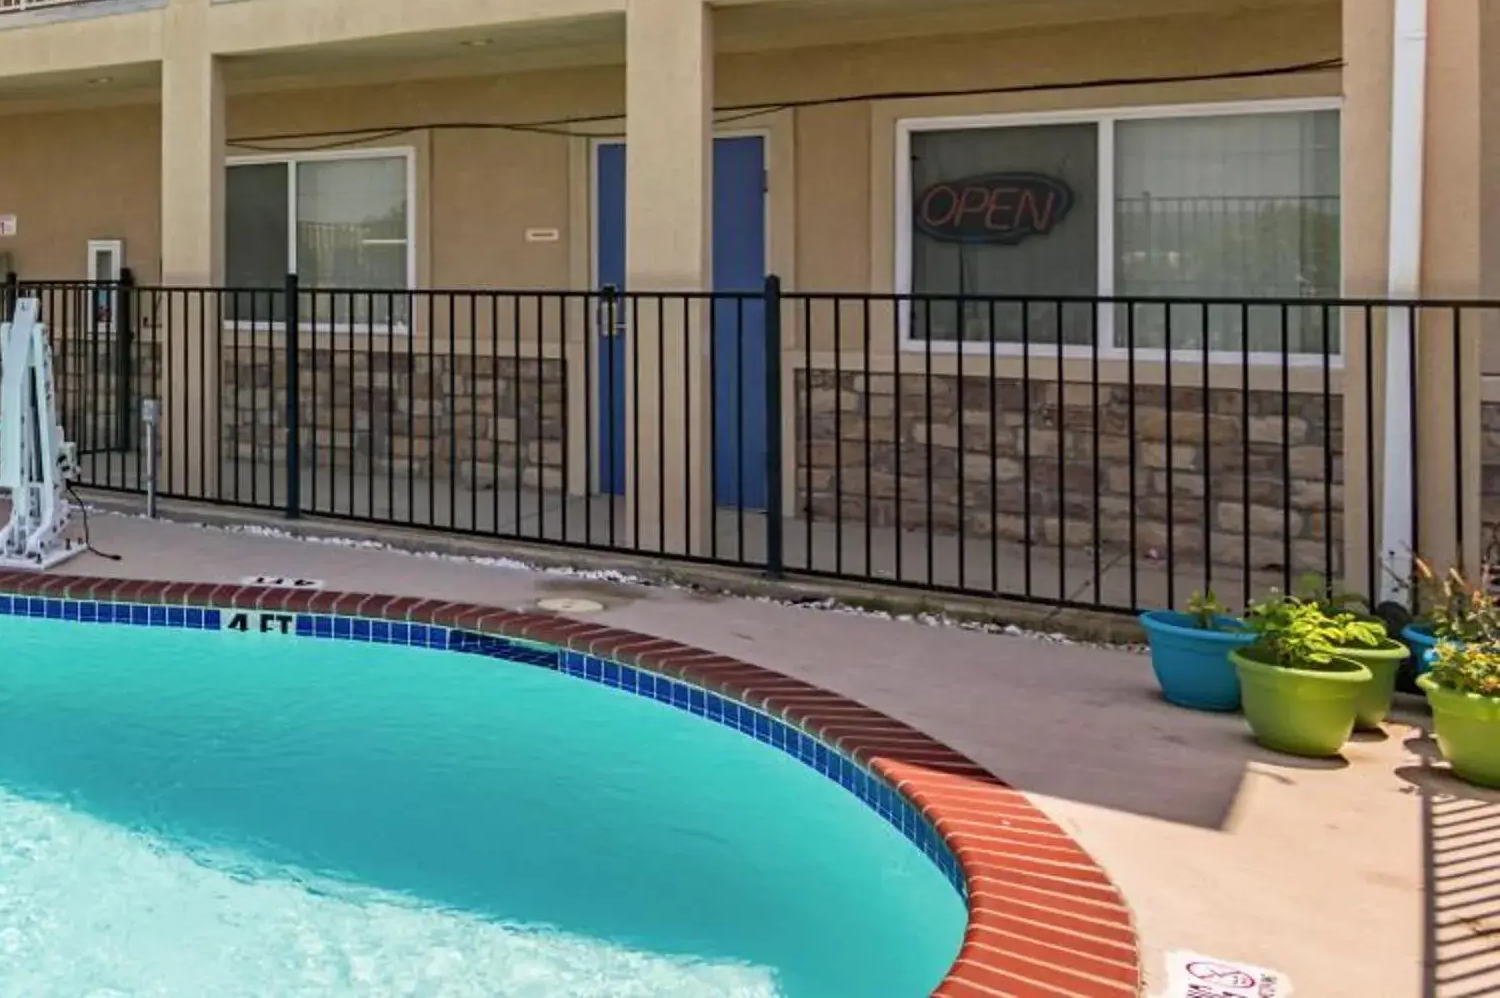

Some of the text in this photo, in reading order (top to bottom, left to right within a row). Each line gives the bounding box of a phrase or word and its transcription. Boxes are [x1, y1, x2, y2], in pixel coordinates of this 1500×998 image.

[921, 185, 1055, 232] OPEN
[228, 613, 293, 634] 4 FT
